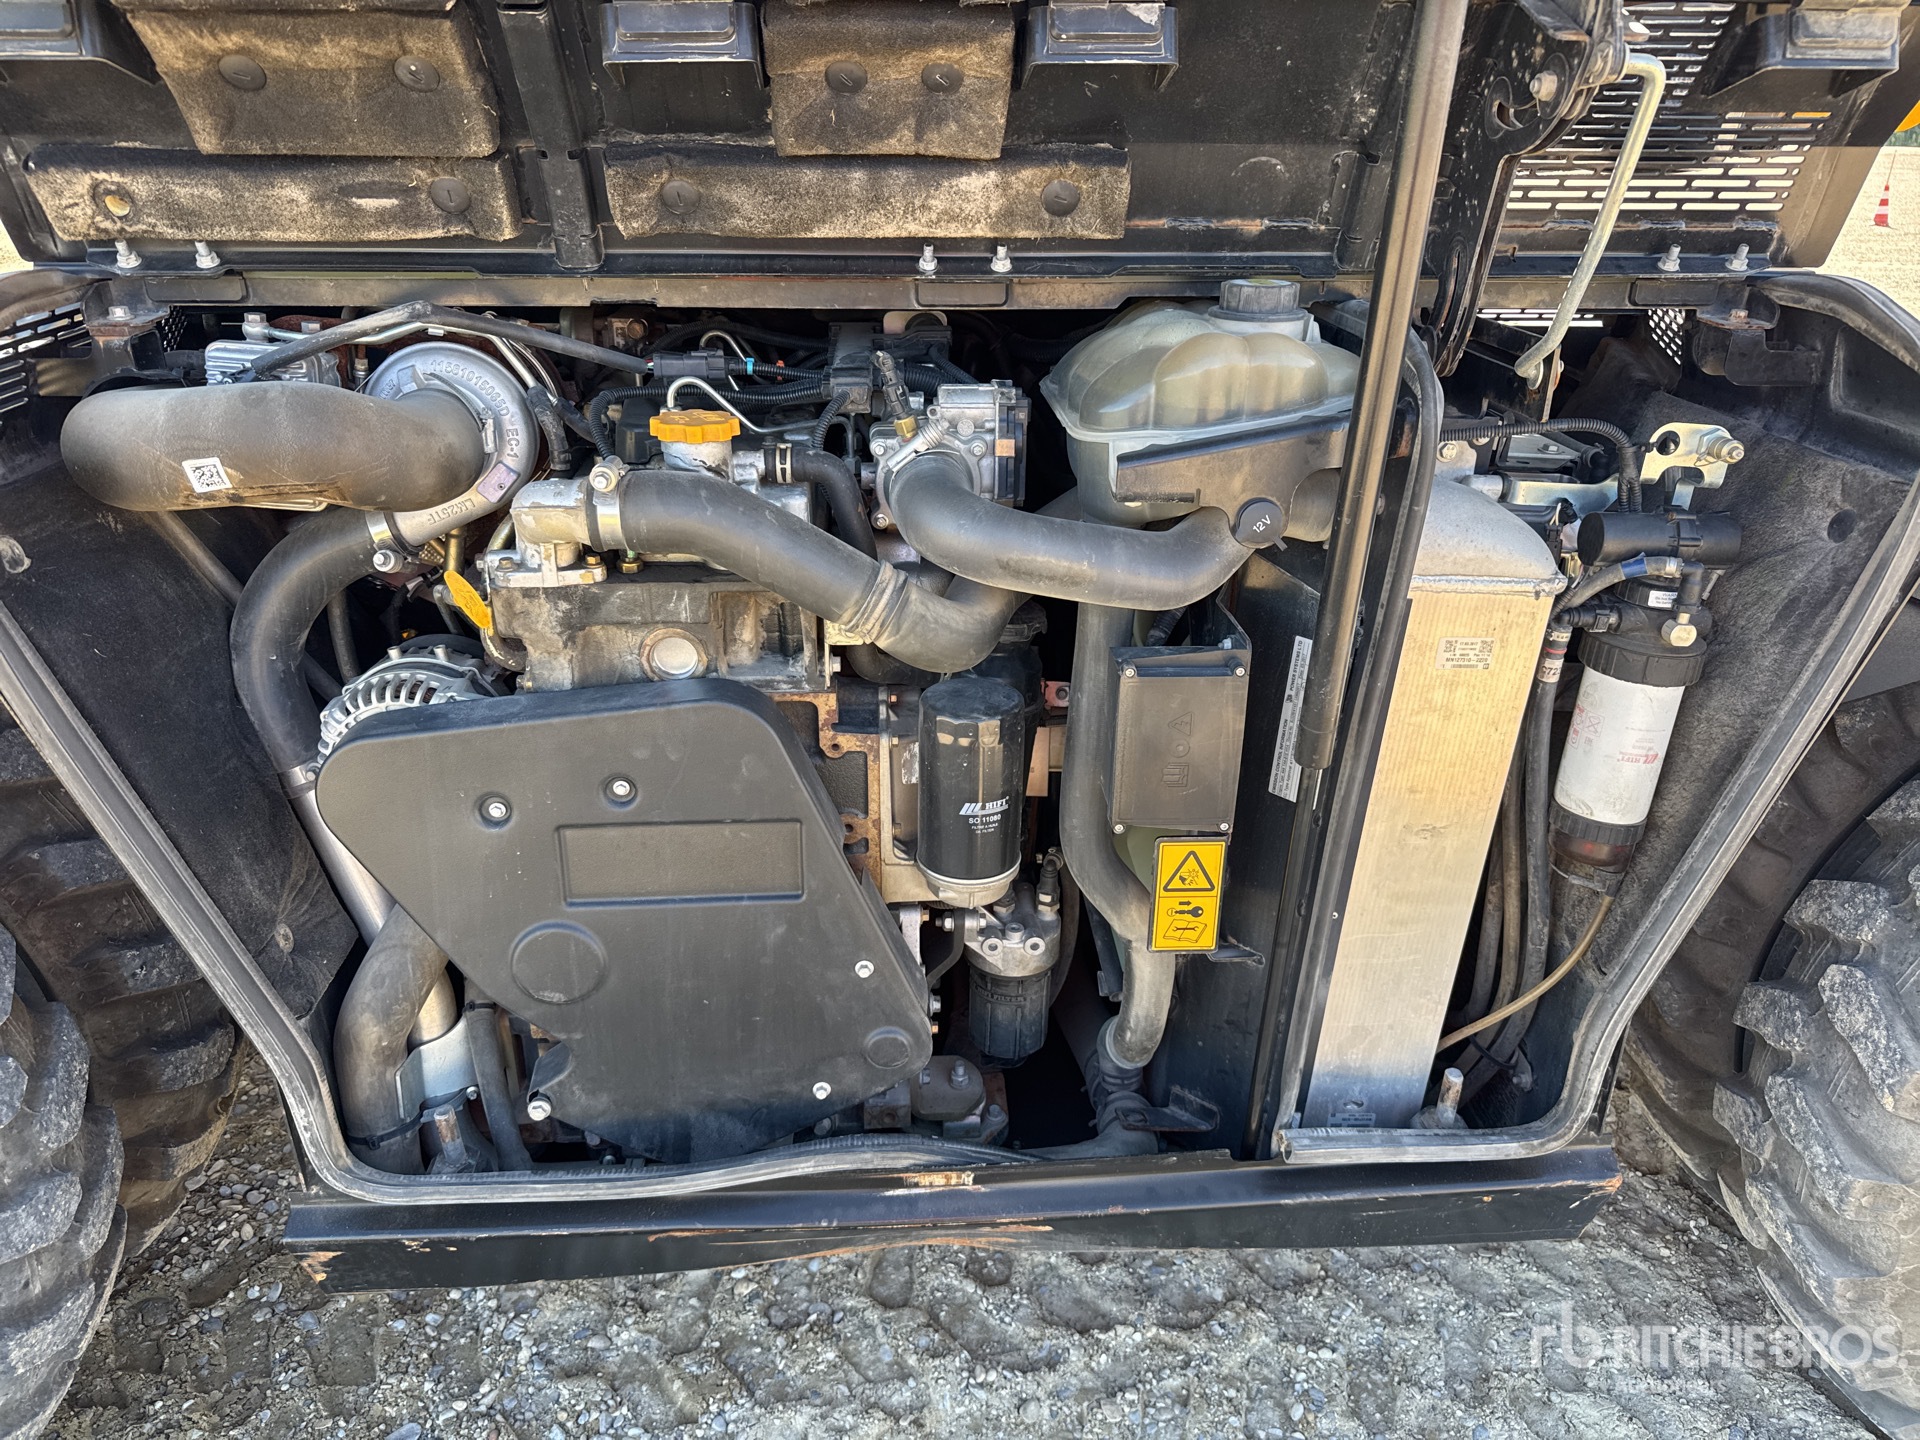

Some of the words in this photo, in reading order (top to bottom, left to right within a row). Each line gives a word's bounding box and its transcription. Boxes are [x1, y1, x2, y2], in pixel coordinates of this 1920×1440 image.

[1252, 514, 1271, 533] 12V
[1280, 719, 1288, 750] INFORMATION
[1293, 651, 1301, 673] SYSTEMS
[985, 798, 1007, 810] HIFI
